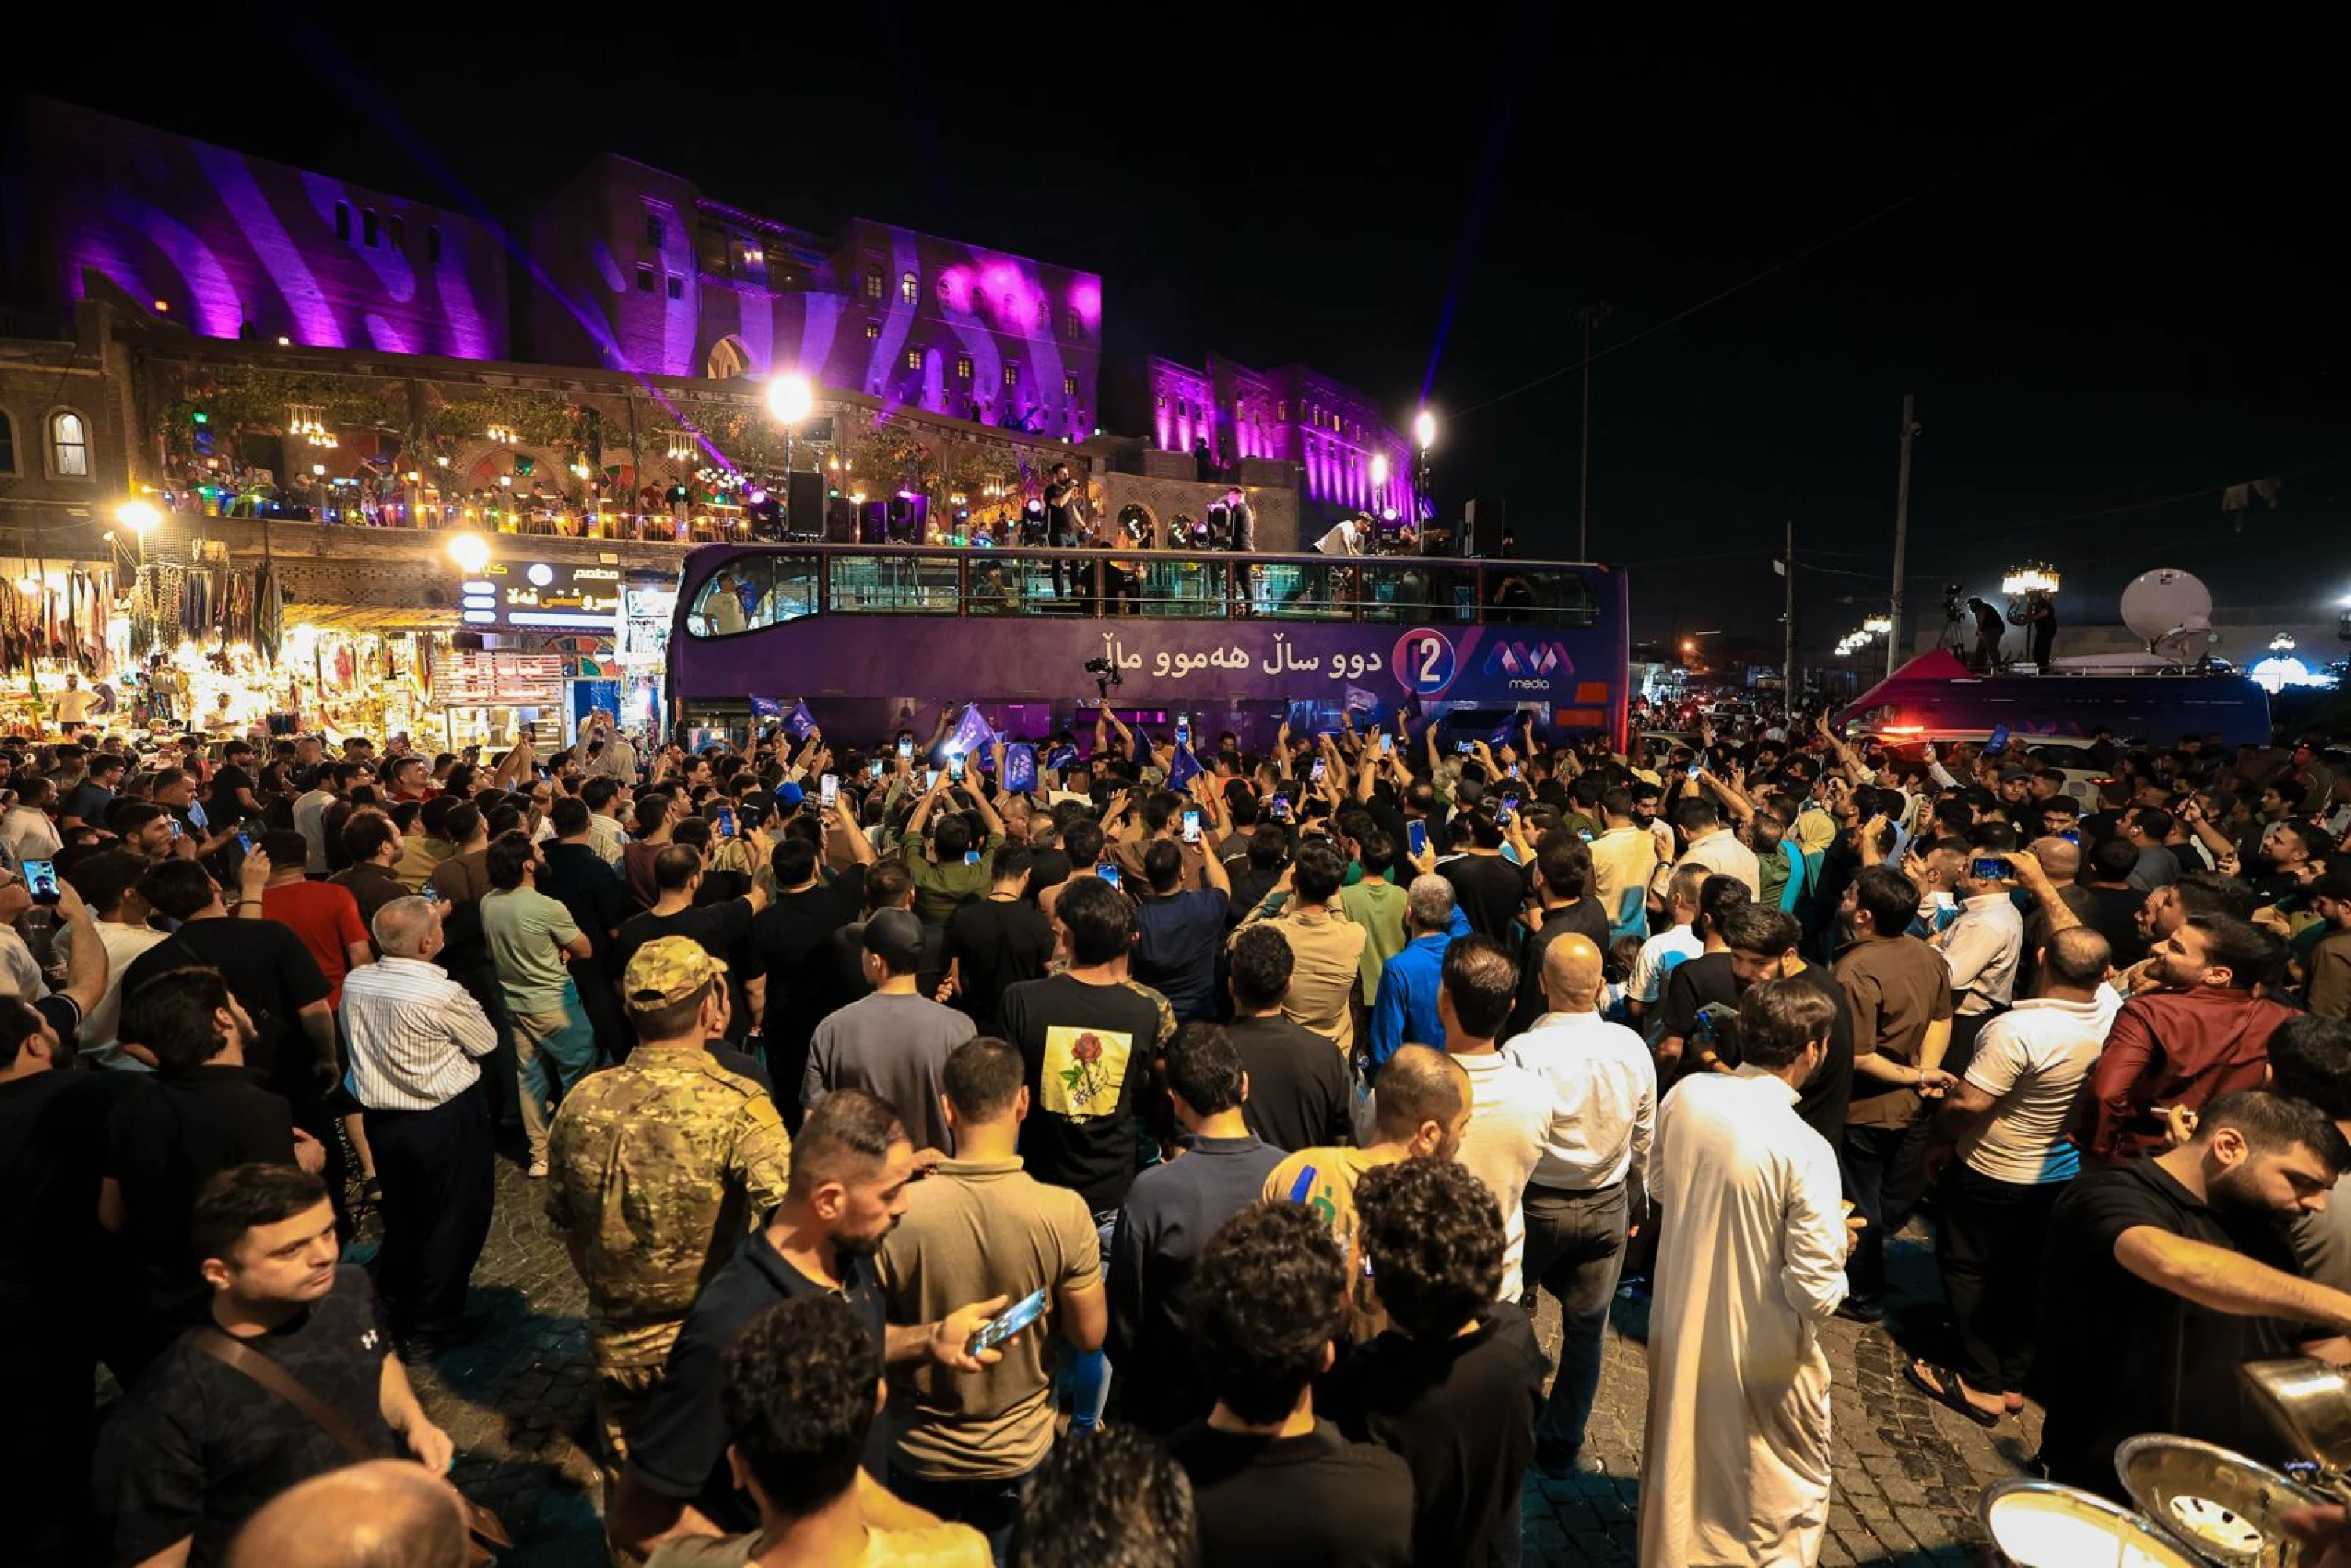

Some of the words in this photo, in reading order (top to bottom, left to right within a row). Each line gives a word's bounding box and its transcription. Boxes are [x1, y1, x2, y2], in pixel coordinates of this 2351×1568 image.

[1152, 646, 1250, 678] هەموو
[1262, 632, 1319, 675] ساڵ
[1328, 652, 1382, 679] دوو
[1509, 679, 1549, 690] media
